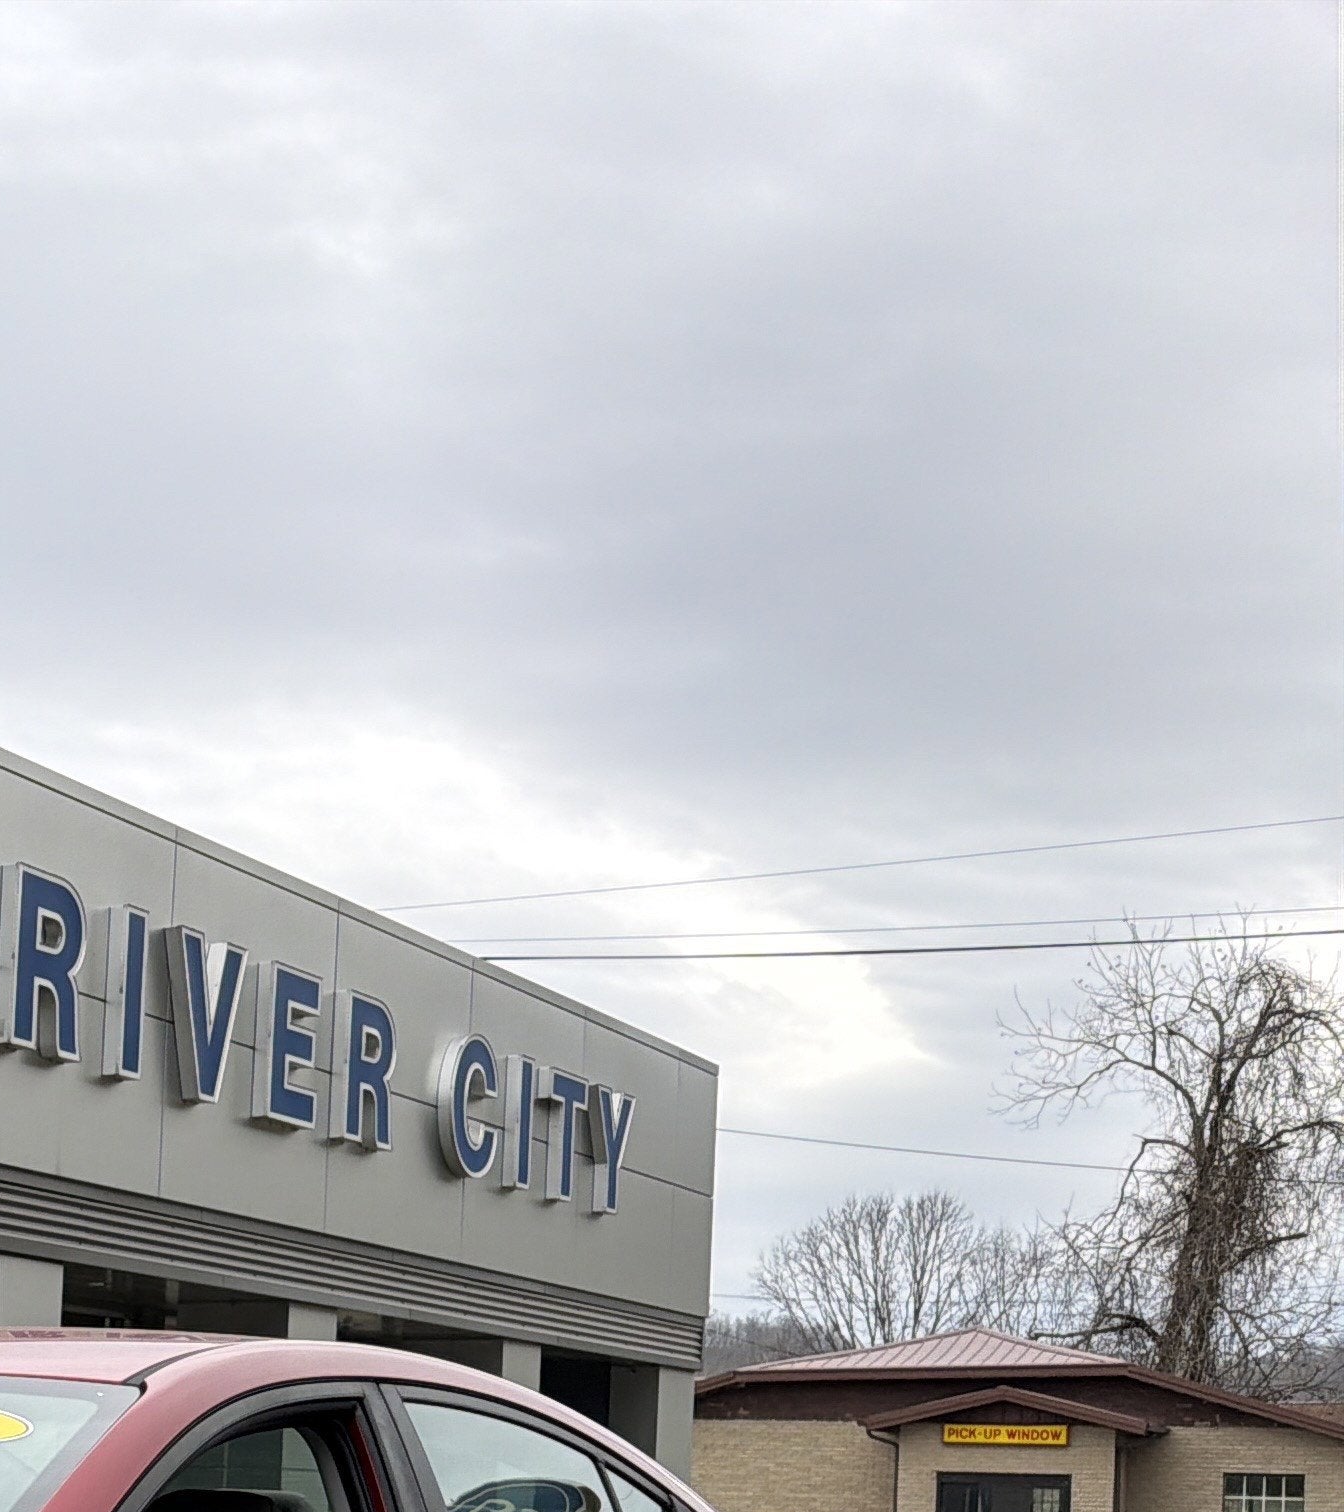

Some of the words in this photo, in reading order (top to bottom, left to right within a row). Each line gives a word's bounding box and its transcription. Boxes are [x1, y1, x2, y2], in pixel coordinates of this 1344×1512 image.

[439, 1034, 636, 1215] CITY
[947, 1427, 1002, 1440] PICK-UP
[1007, 1428, 1062, 1441] WINDOW
